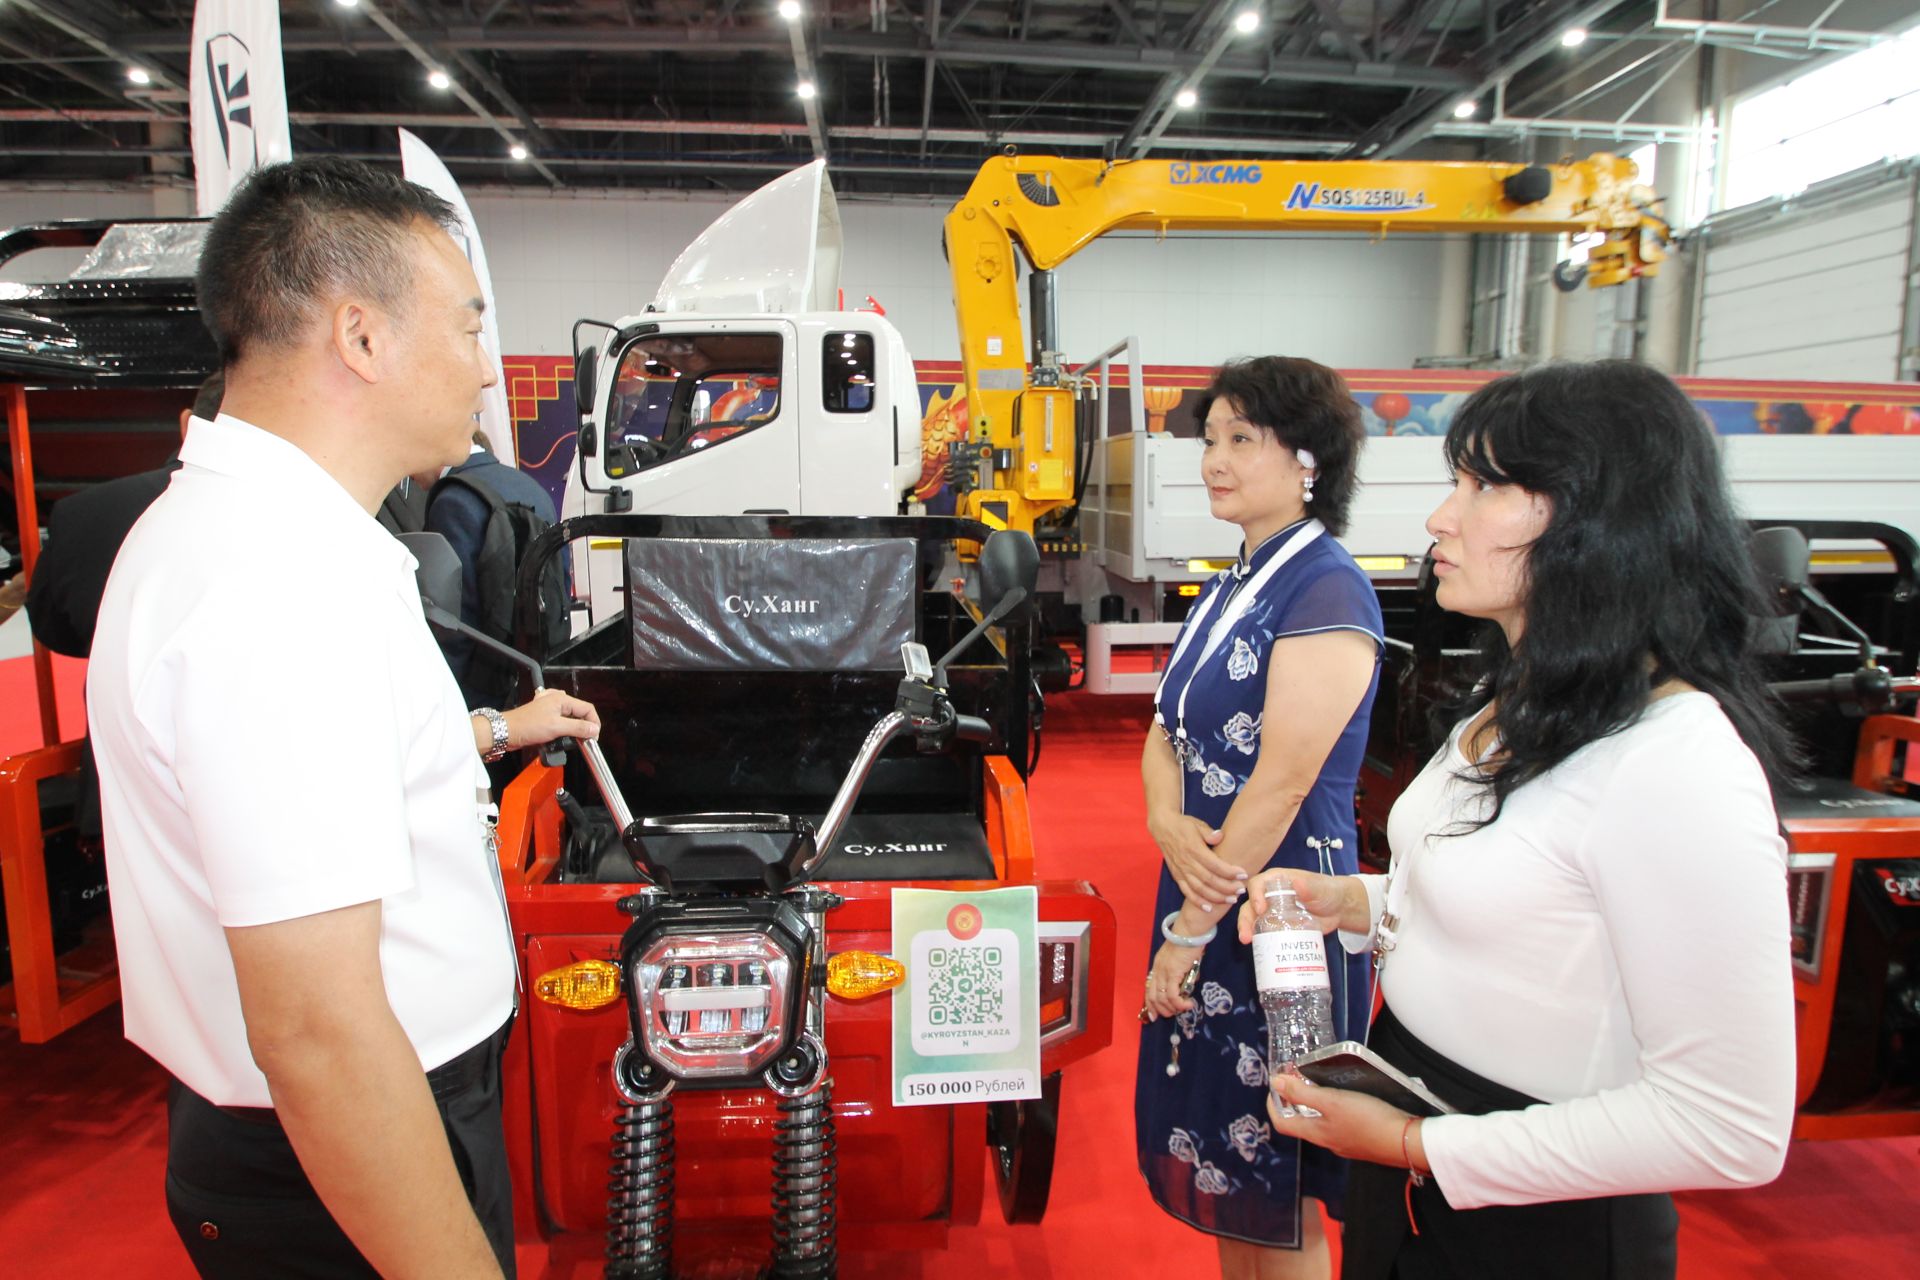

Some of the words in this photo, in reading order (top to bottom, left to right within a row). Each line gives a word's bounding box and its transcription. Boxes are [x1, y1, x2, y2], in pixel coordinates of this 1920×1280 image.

[1194, 165, 1262, 184] XCMG
[724, 594, 820, 617] Су.Ханг
[844, 843, 947, 856] Су.Ханг
[1281, 941, 1314, 951] INVEST
[1276, 953, 1324, 962] TATARSTAN
[920, 1028, 1011, 1040] @KYRGYZSTAN_KAZA
[908, 1083, 936, 1096] 150
[940, 1081, 971, 1095] 000
[975, 1077, 1025, 1095] Рублей
